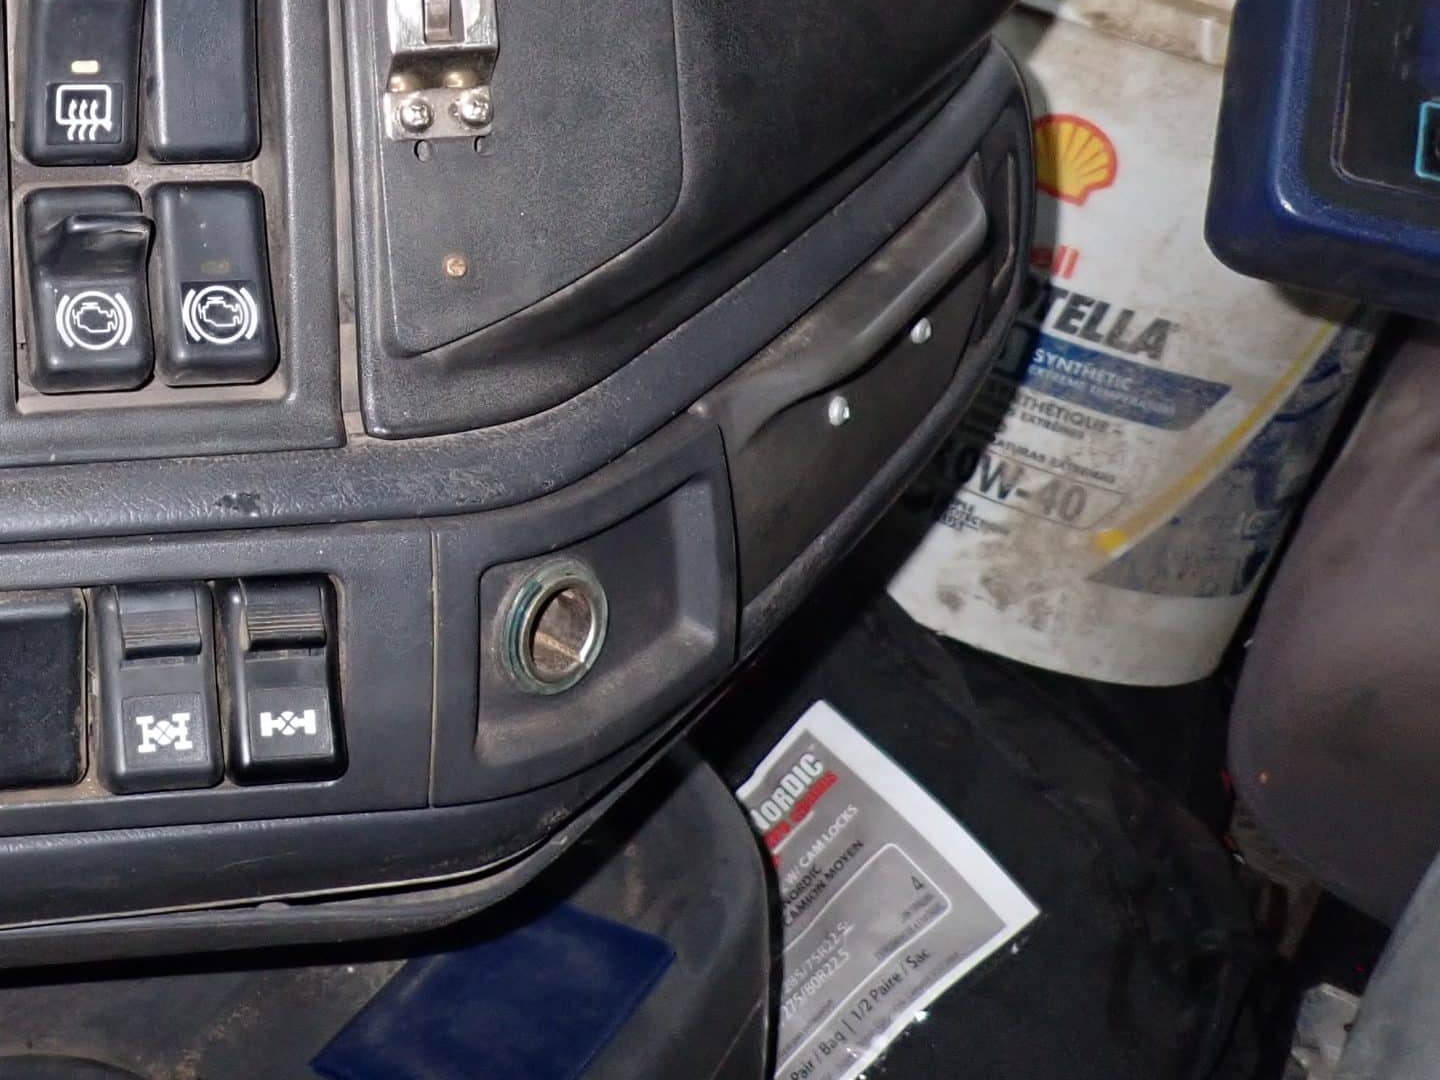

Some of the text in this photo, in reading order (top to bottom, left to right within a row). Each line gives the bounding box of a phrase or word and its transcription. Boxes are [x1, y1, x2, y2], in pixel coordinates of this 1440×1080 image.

[1029, 245, 1080, 280] ell
[1033, 288, 1172, 361] TELLA
[799, 839, 825, 869] CAM
[822, 803, 858, 839] LOCKS
[824, 840, 865, 880] MOYEN
[911, 875, 924, 891] 4
[851, 999, 874, 1021] 1/2
[869, 971, 904, 1002] Paire
[905, 948, 931, 970] Sac
